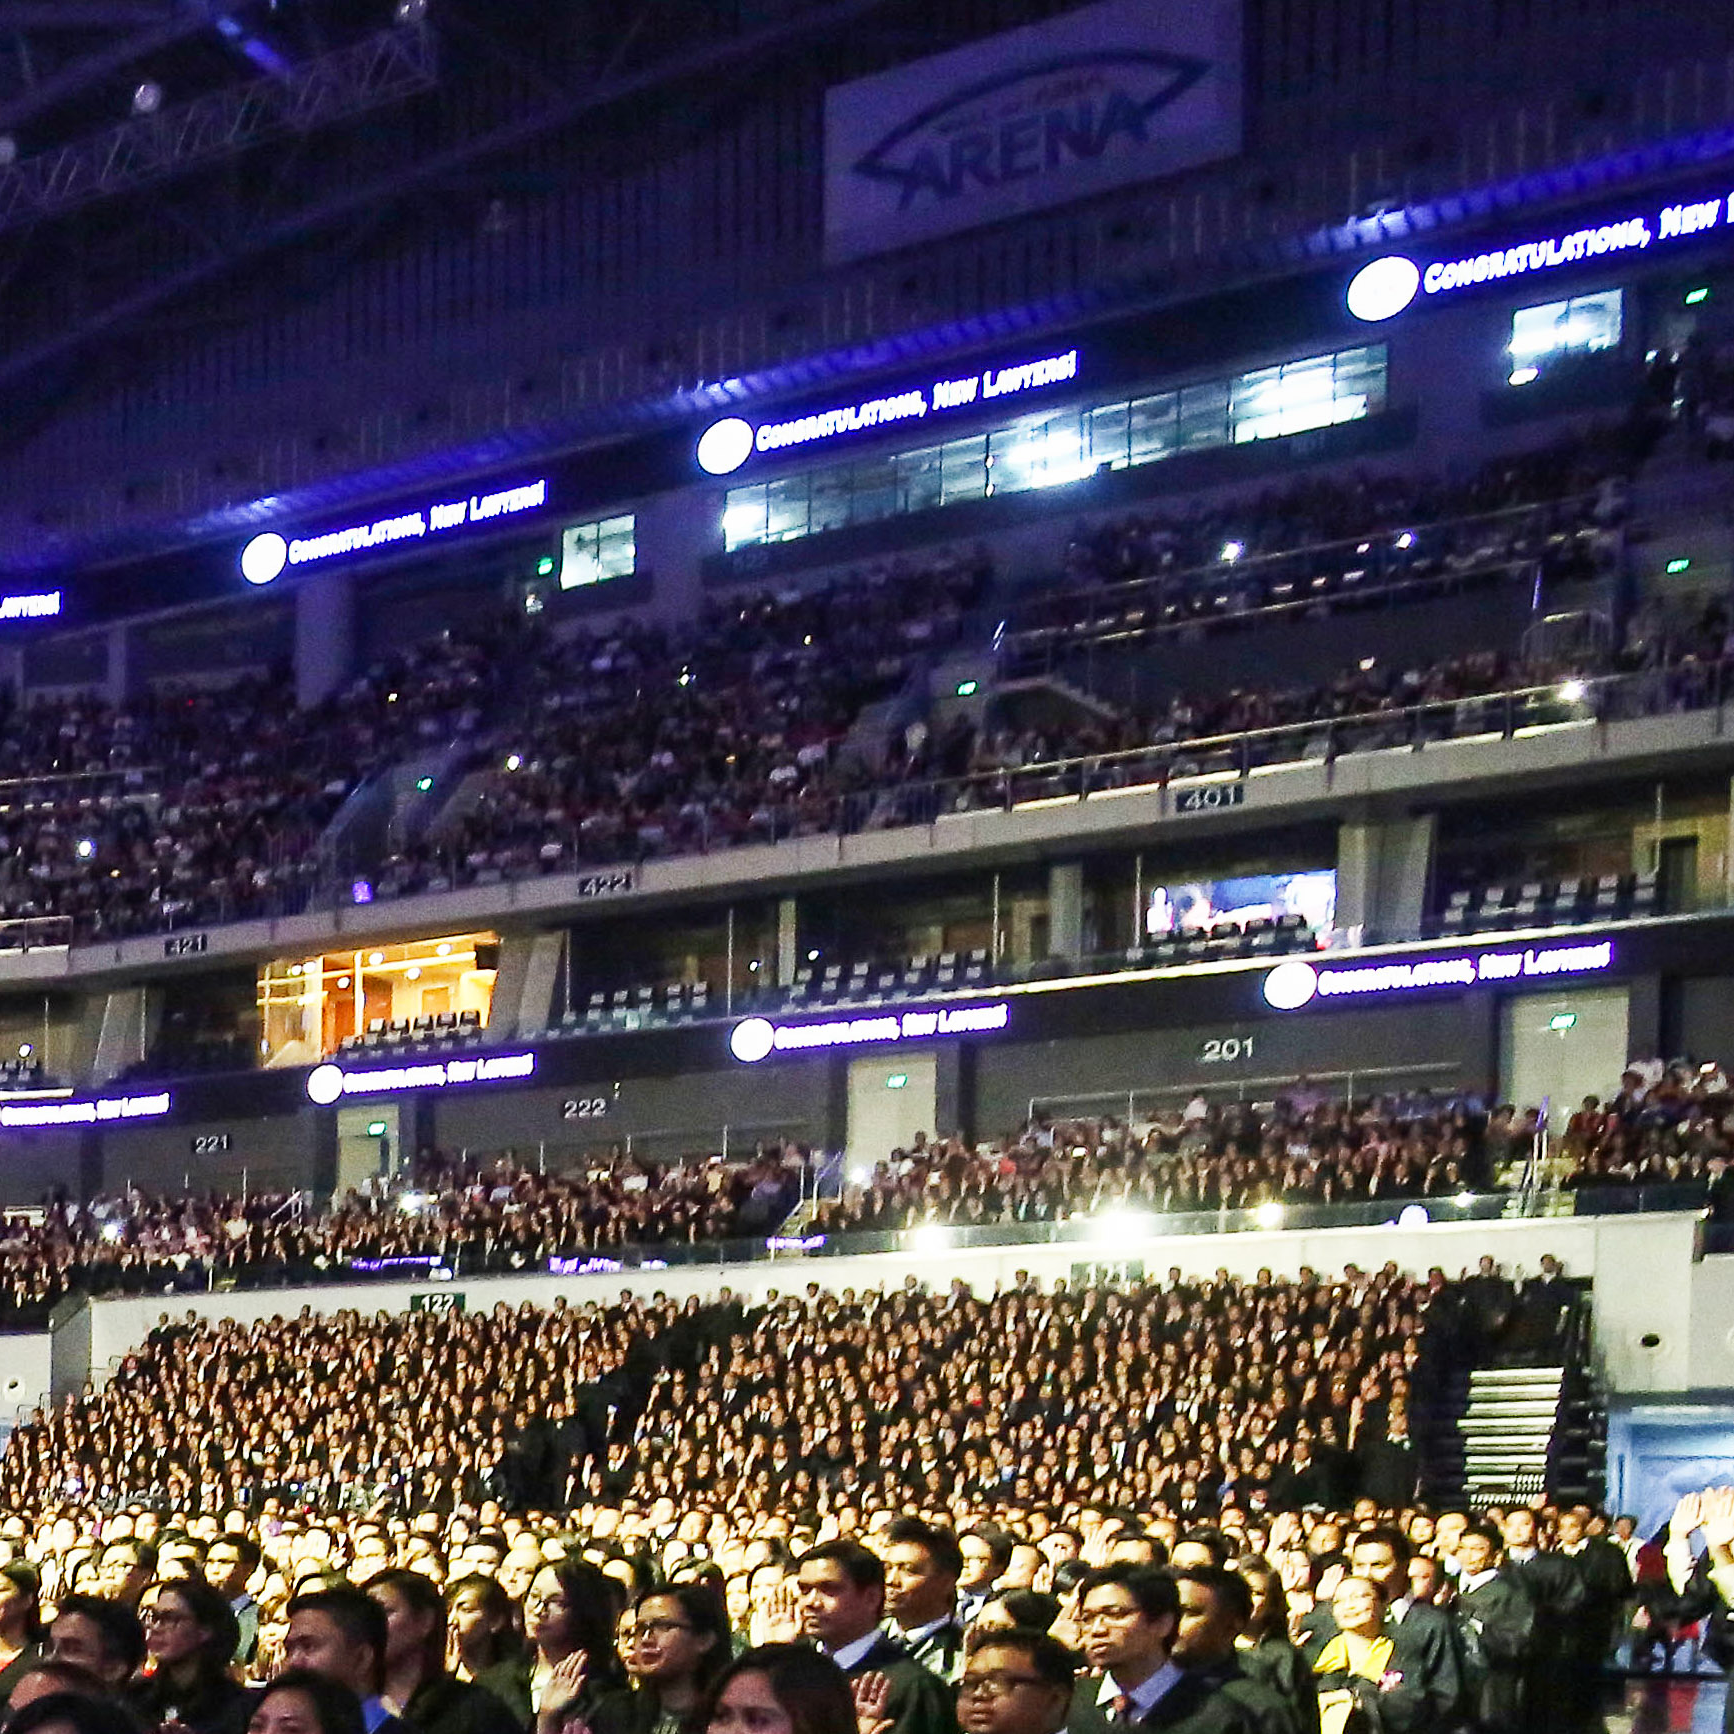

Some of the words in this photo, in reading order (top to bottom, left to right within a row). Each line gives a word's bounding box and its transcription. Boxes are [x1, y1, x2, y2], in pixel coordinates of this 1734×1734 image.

[897, 90, 1149, 211] ARENA
[1185, 784, 1236, 811] 401
[1203, 1036, 1254, 1062] 201
[564, 1097, 606, 1119] 222
[195, 1135, 227, 1154] 221
